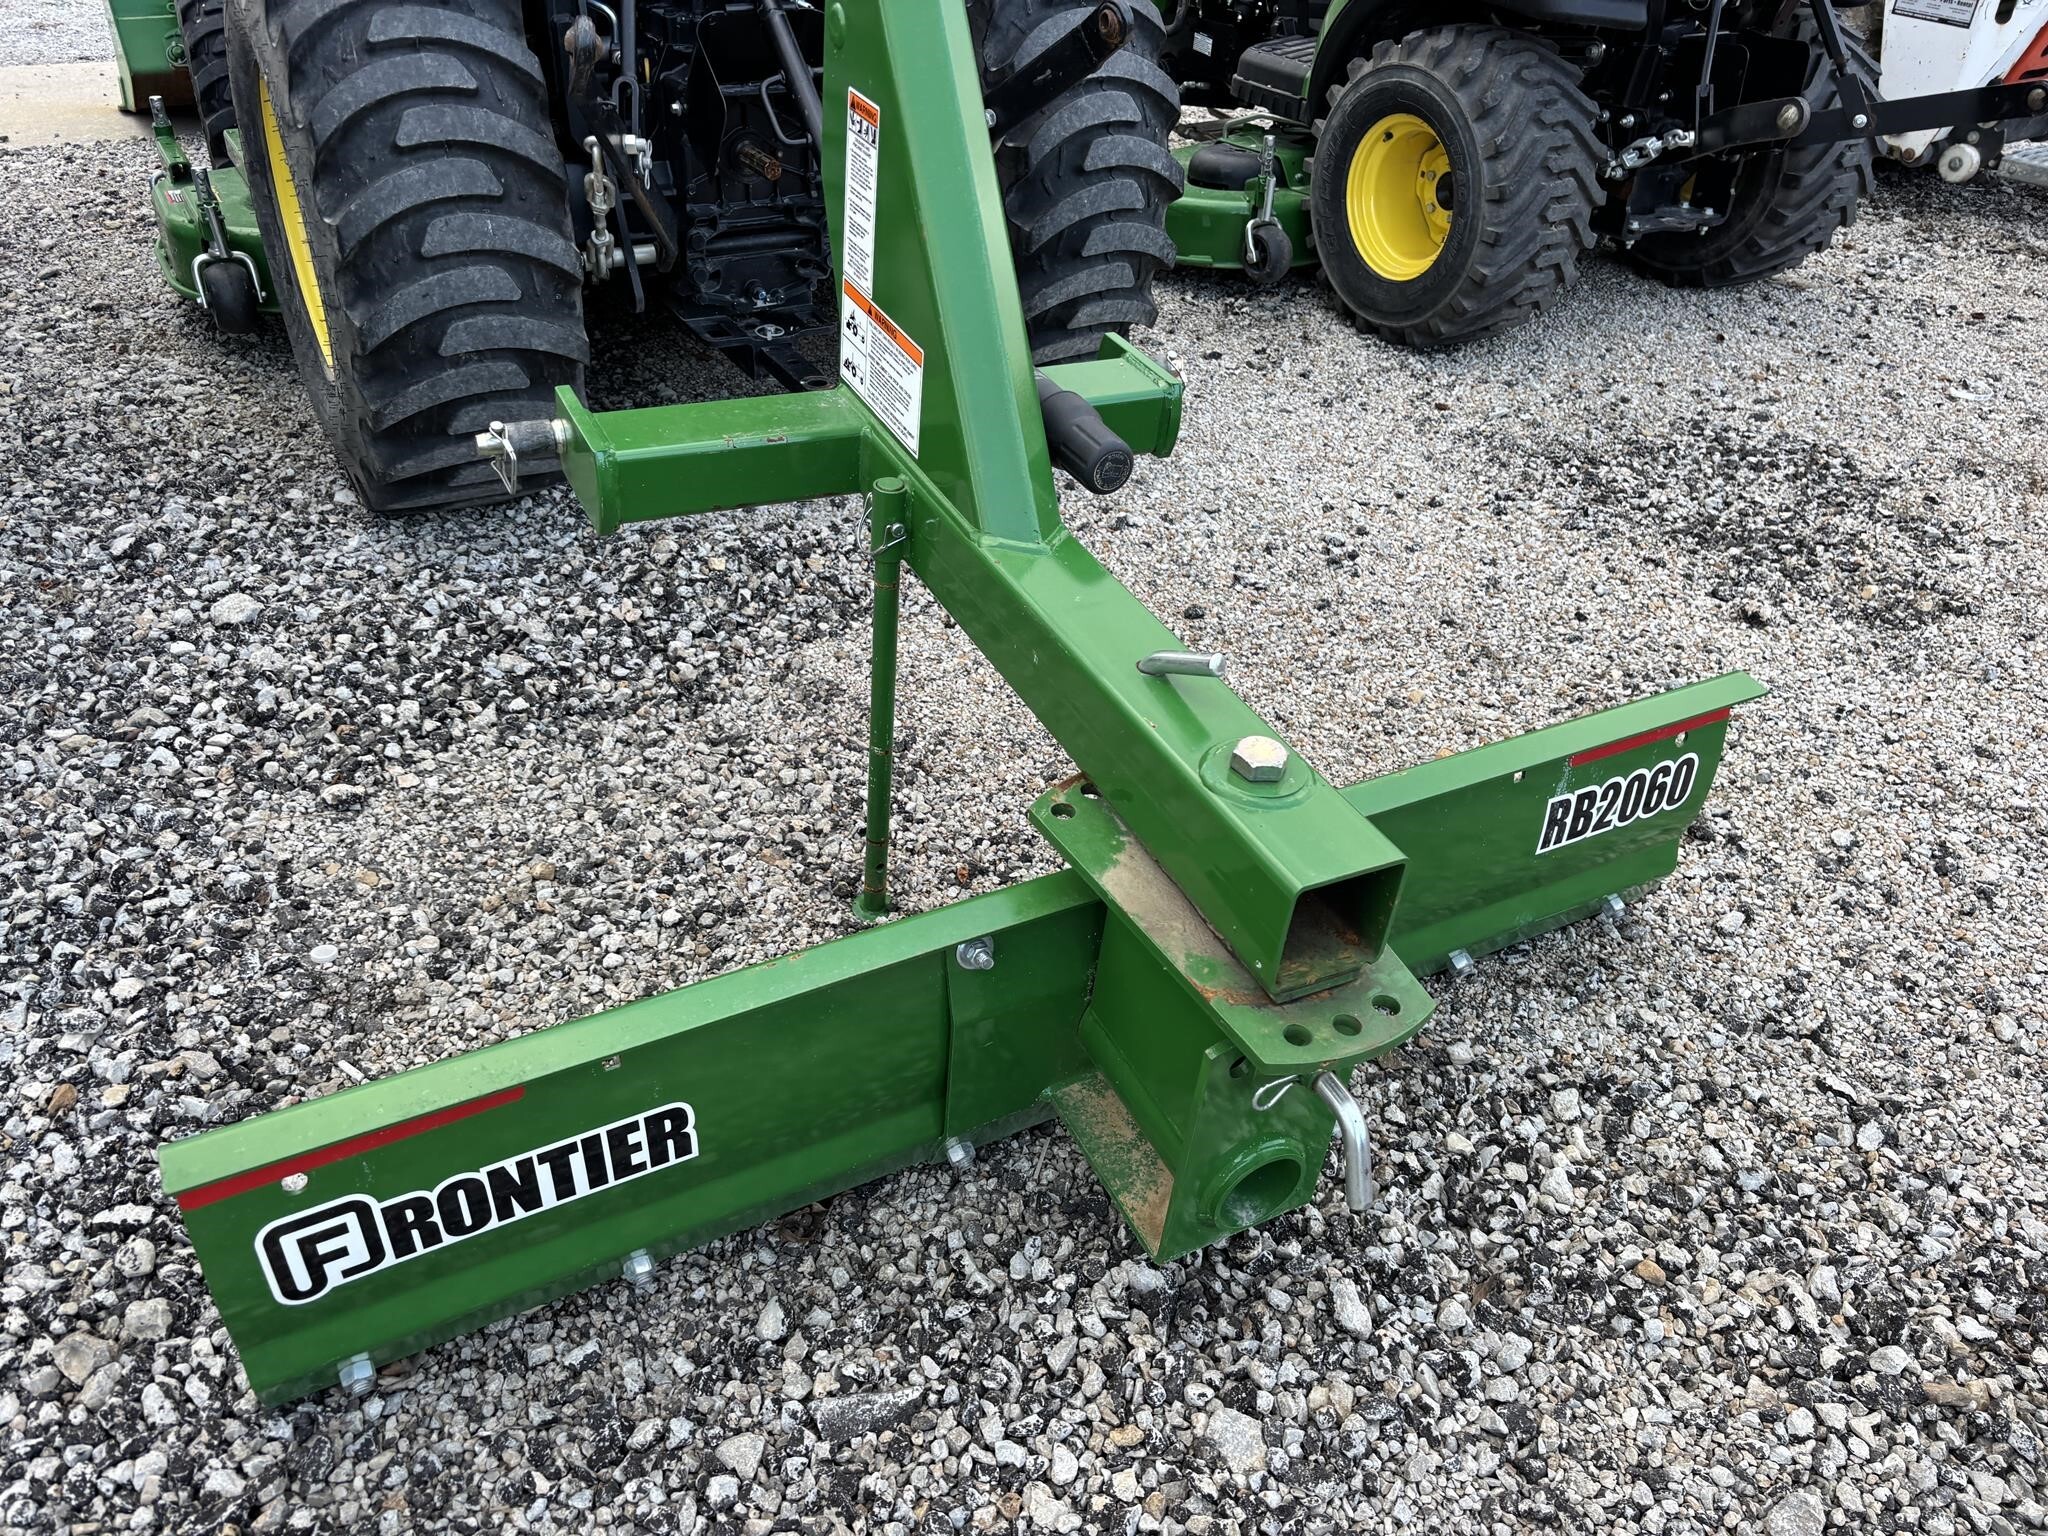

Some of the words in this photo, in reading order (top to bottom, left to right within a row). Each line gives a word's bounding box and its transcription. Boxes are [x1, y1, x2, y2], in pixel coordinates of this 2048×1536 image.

[855, 100, 878, 124] WARNING
[874, 310, 897, 340] WARNING
[1539, 756, 1696, 851] RB2060
[261, 1105, 695, 1301] FRONTIER
